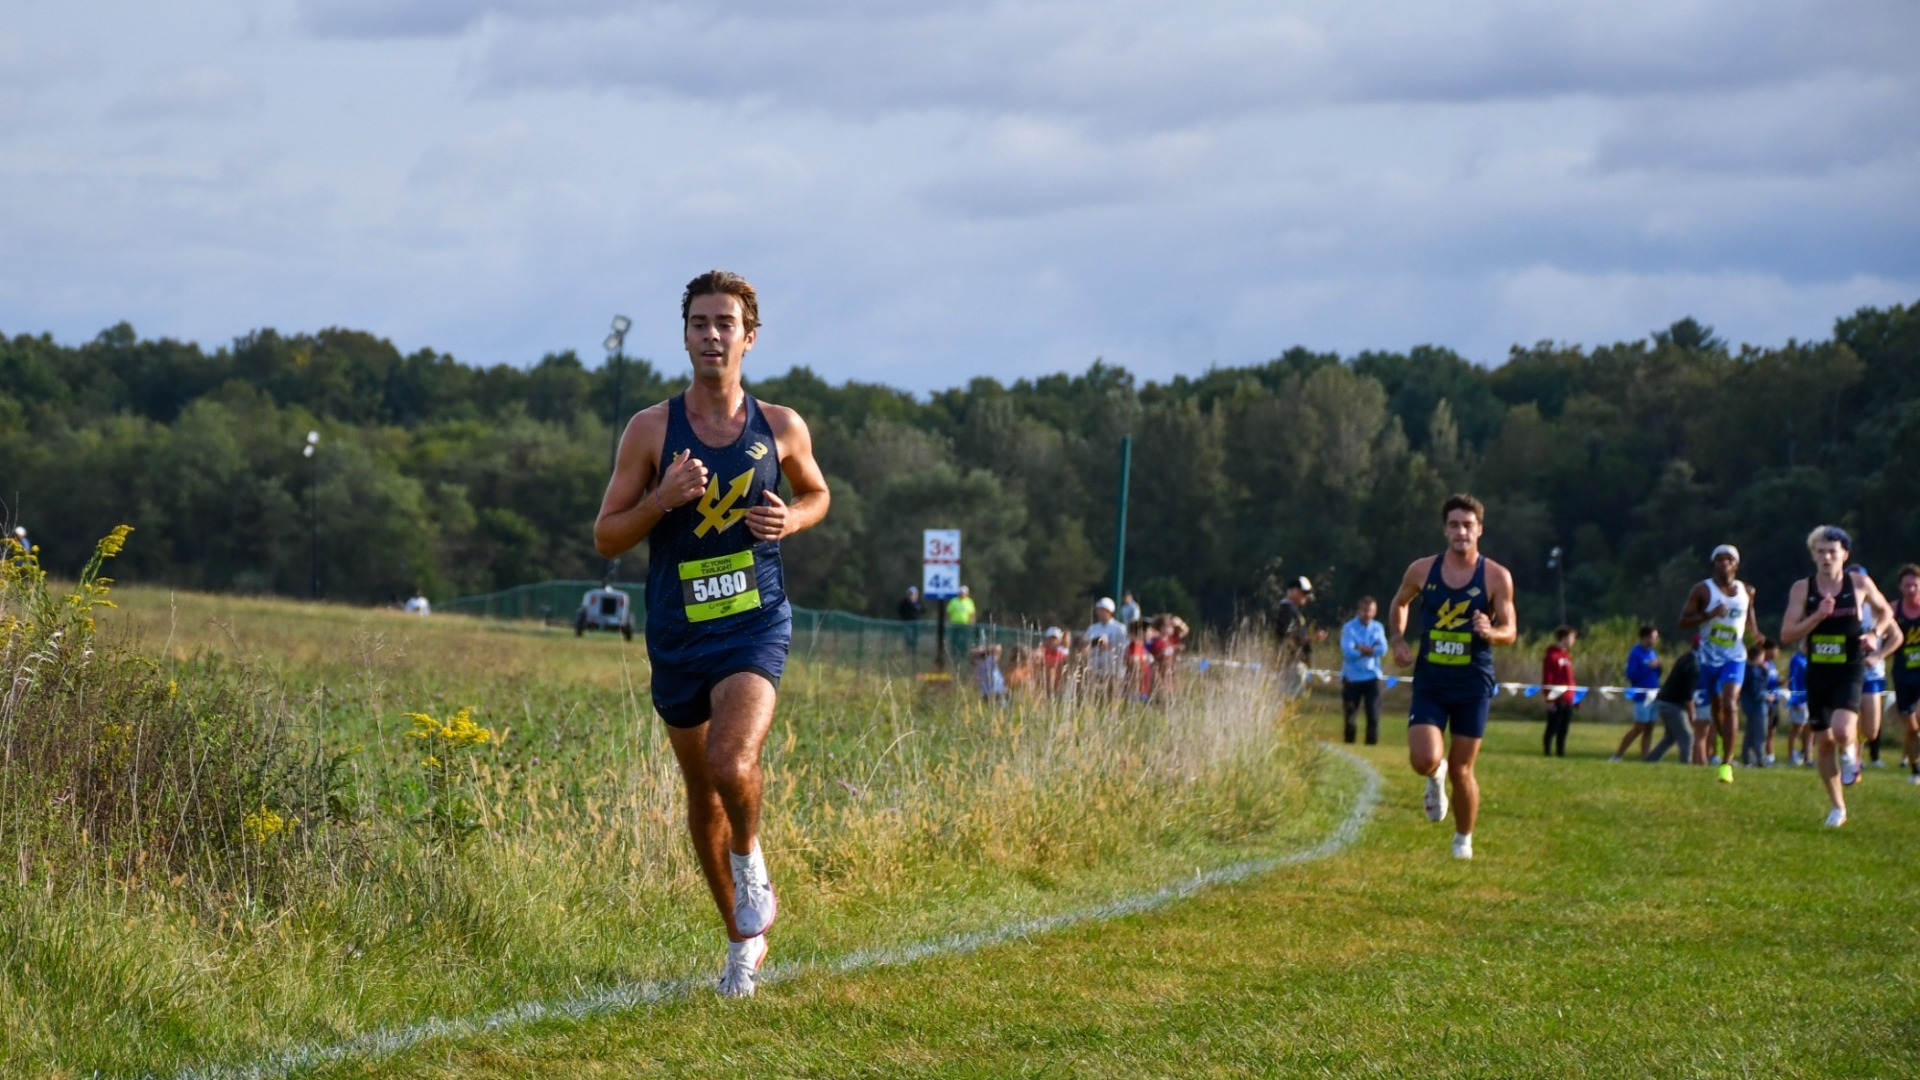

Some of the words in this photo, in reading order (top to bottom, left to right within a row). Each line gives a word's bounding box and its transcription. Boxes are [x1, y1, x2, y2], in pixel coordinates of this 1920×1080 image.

[928, 538, 955, 557] 3K
[701, 563, 732, 575] TWILIGHT
[710, 558, 732, 567] TOWN
[692, 570, 747, 602] 5480
[928, 573, 954, 589] 4K
[1435, 640, 1464, 655] 5479
